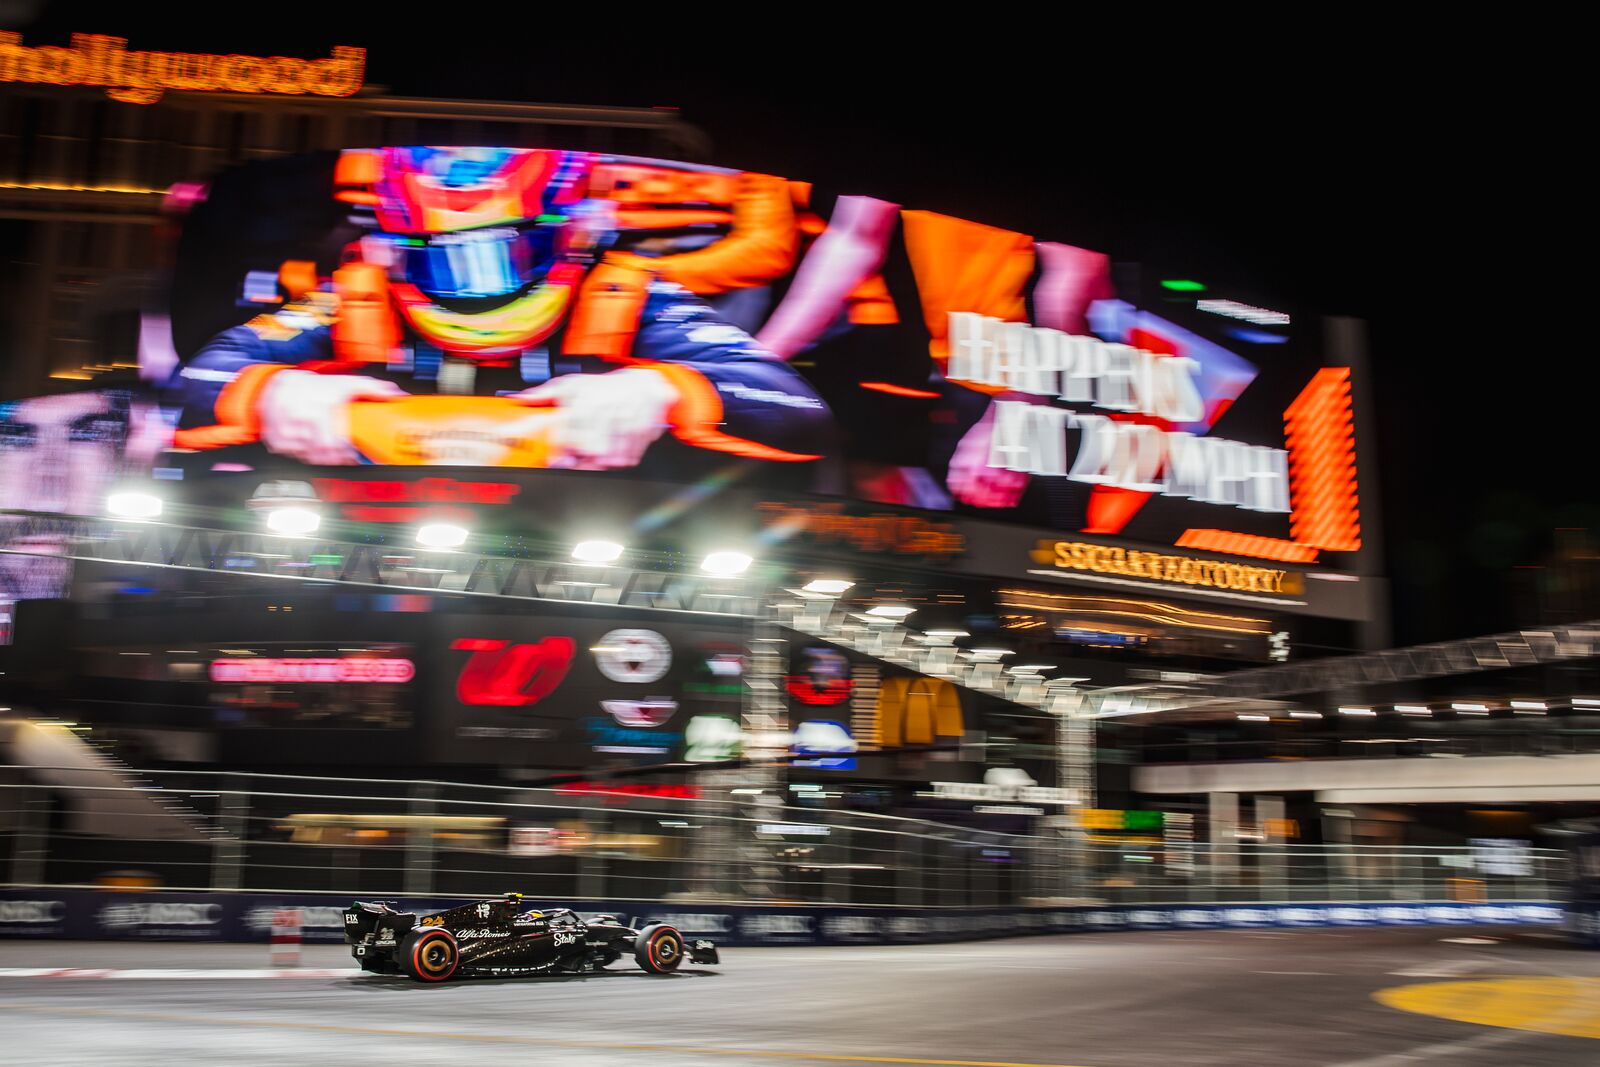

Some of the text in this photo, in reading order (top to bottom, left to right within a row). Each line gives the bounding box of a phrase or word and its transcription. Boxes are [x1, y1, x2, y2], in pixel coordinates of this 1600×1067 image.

[345, 913, 359, 923] FIX
[422, 915, 445, 927] 24
[456, 928, 511, 941] Alfa Romeo
[553, 932, 577, 947] Stake
